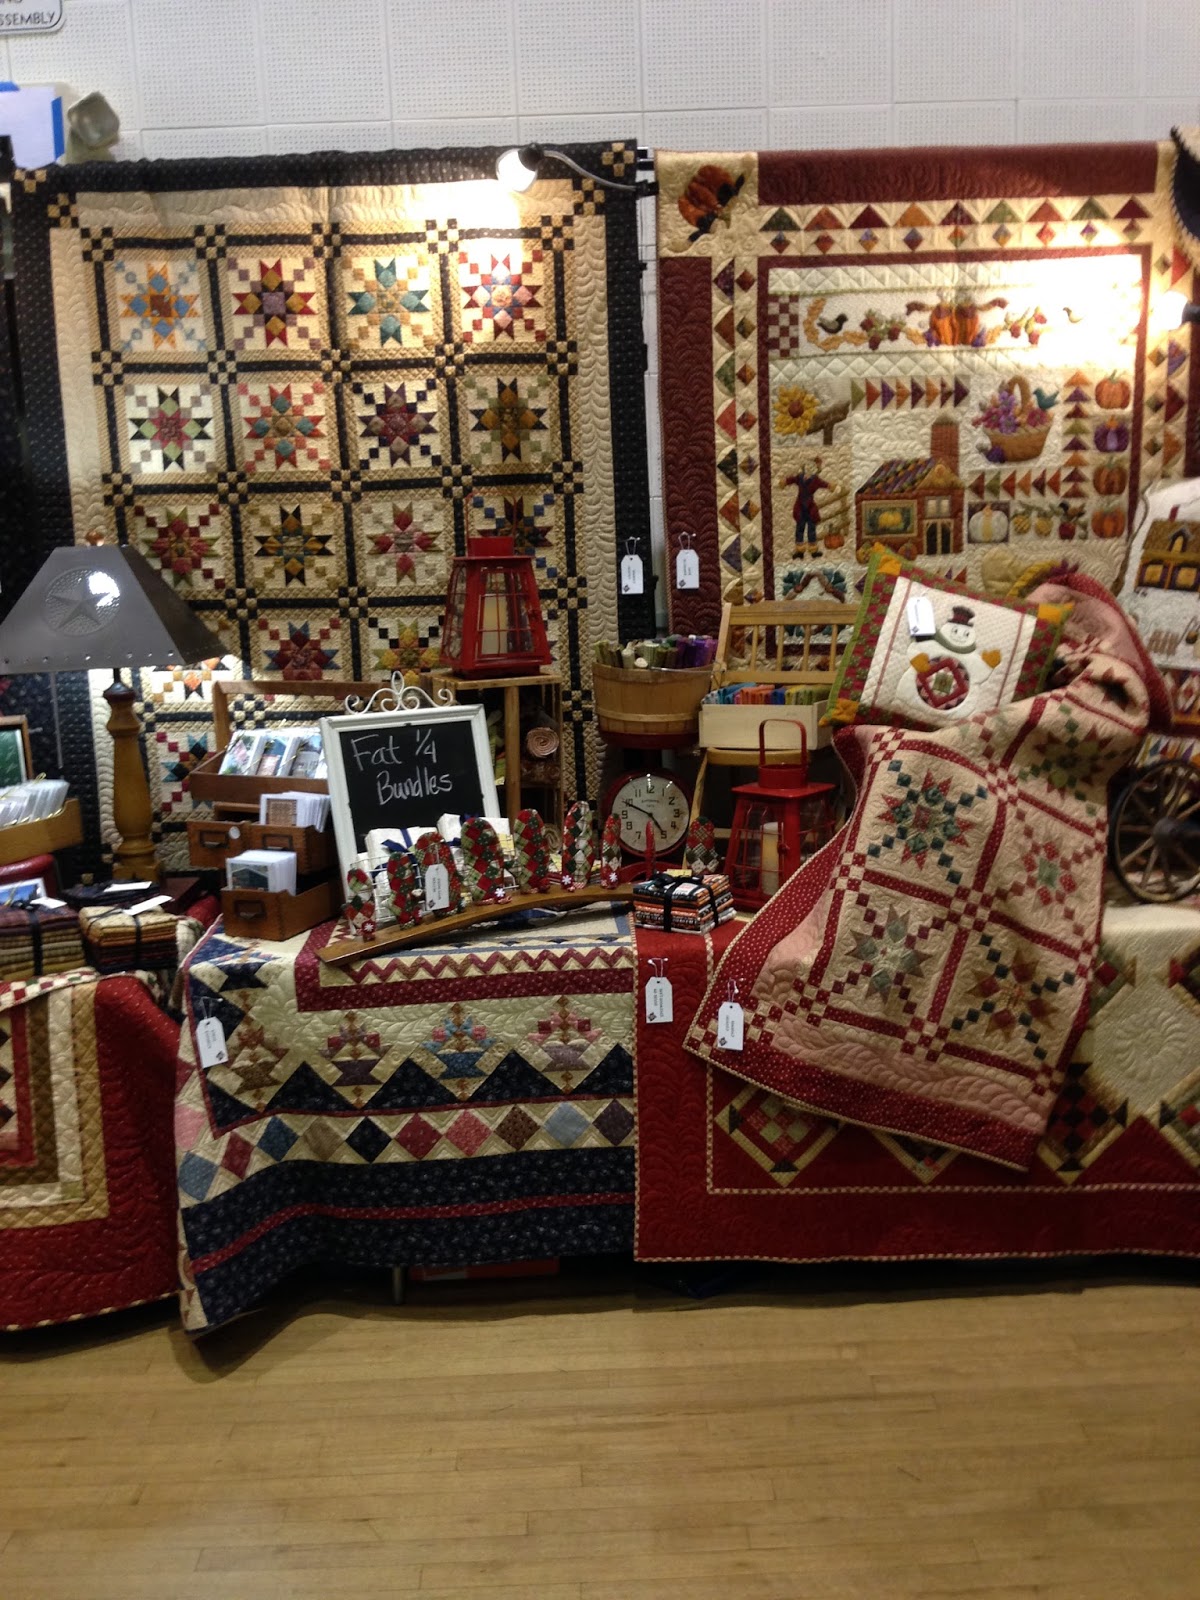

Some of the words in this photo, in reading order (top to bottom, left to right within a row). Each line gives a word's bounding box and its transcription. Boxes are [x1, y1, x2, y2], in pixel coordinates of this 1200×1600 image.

[350, 734, 402, 771] Fat
[376, 765, 453, 805] Bundles
[635, 789, 642, 797] 11
[669, 797, 675, 805] 2
[621, 810, 628, 819] 9
[674, 809, 680, 818] 3
[626, 821, 632, 830] 8
[670, 821, 676, 830] 4
[635, 831, 641, 839] 7
[661, 831, 667, 839] 5
